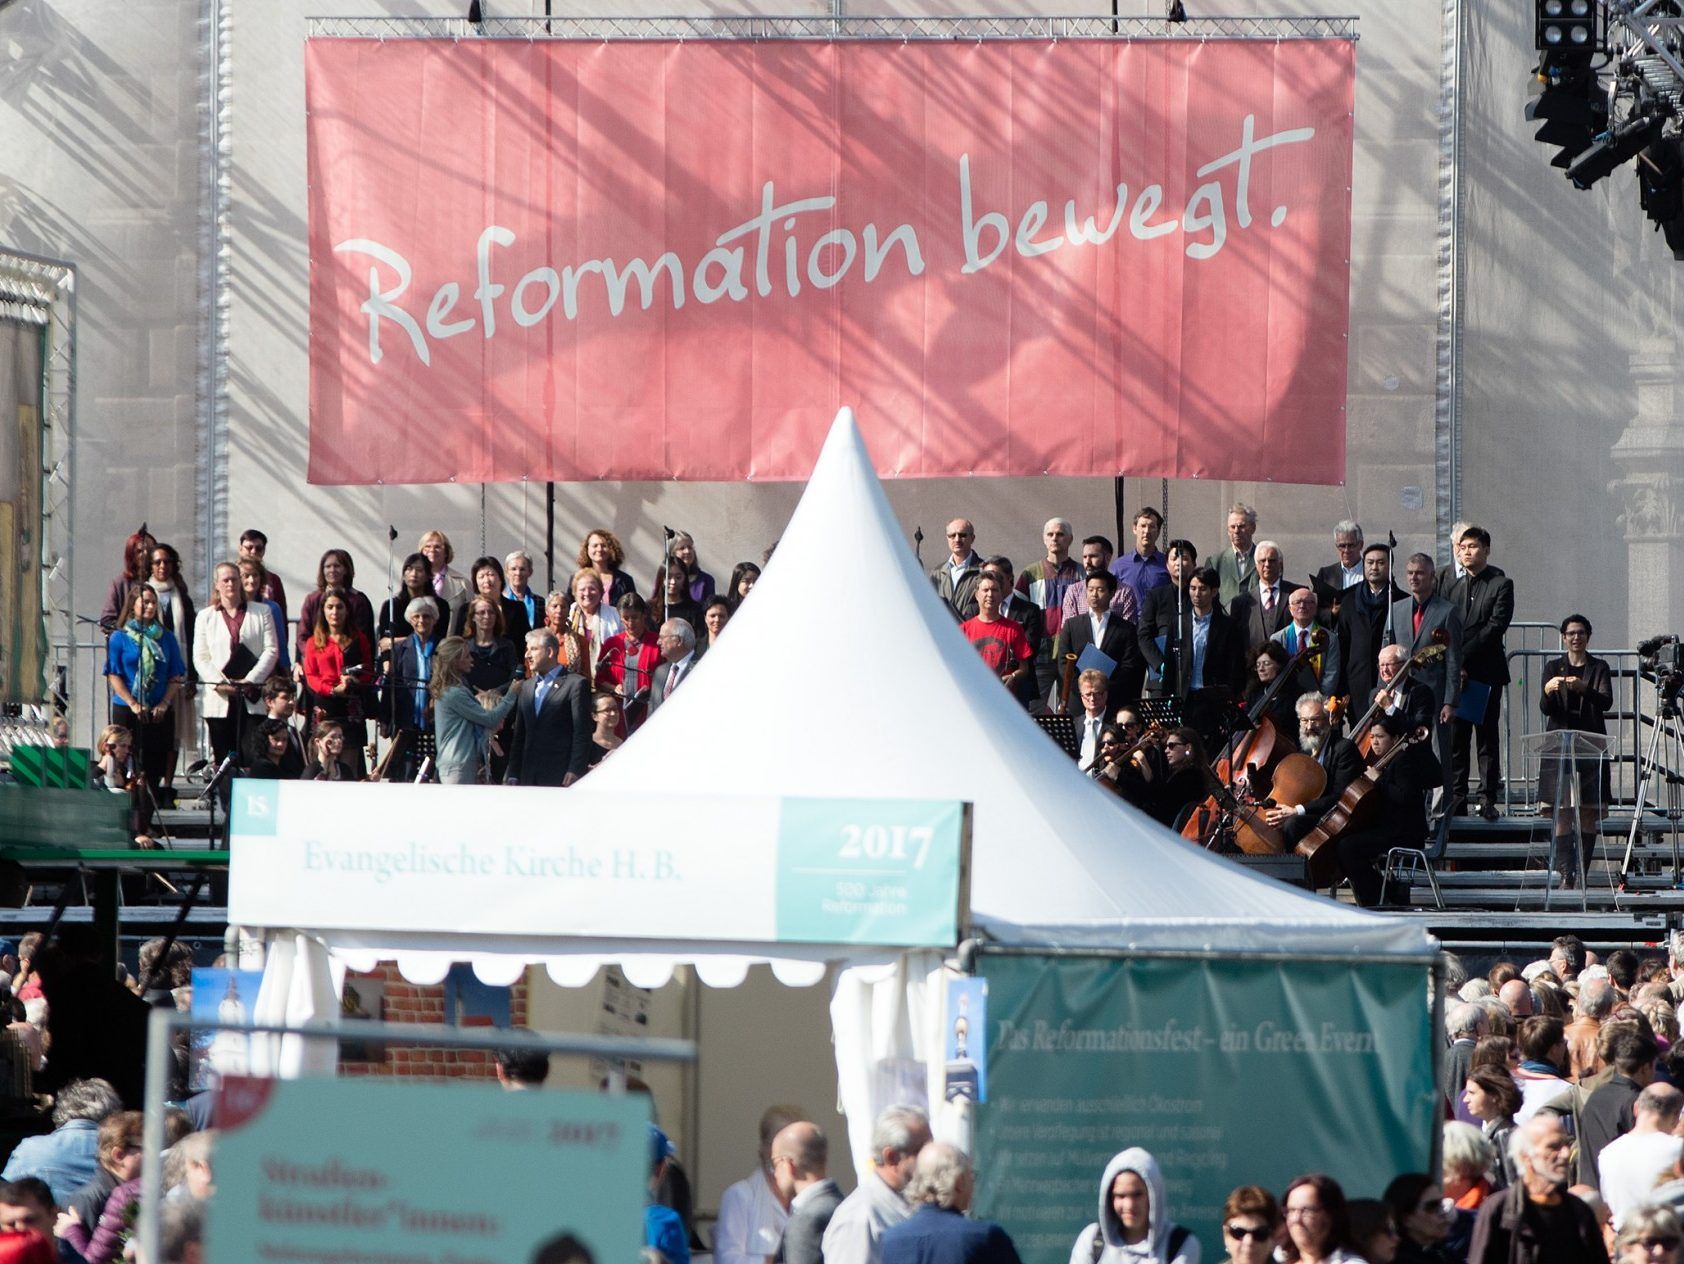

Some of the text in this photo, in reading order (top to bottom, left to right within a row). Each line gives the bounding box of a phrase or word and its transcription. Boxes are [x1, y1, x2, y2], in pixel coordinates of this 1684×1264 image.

[334, 114, 1315, 367] Reformation bewegt.
[303, 841, 684, 882] Evangelische Kirche H. B.
[837, 823, 934, 871] 2017
